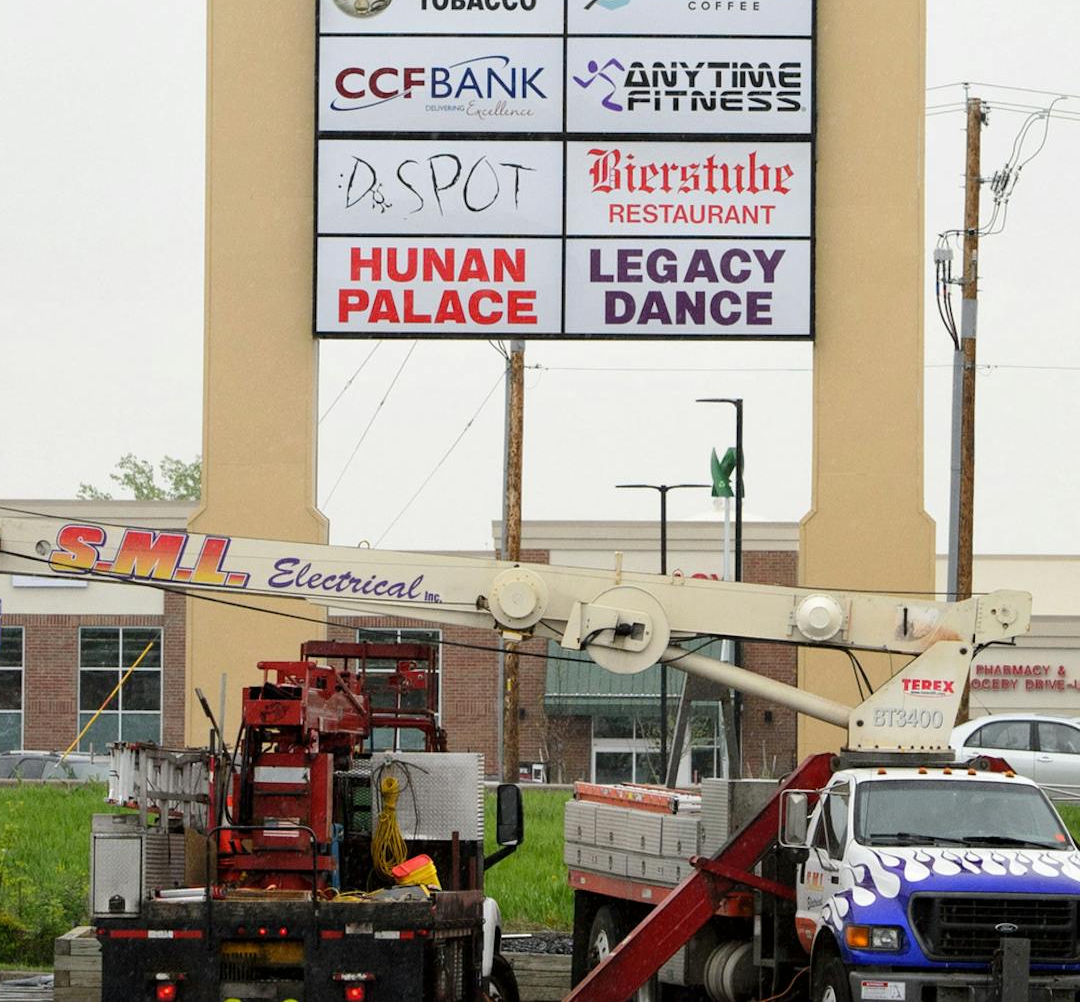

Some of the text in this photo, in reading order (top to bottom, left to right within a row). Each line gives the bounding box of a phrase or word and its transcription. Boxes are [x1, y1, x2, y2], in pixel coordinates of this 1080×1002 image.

[688, 1, 760, 11] COFFEE
[624, 61, 801, 88] ANYTIME
[425, 99, 535, 119] DELIVERING Excellence
[627, 90, 802, 112] FITNESS
[587, 149, 794, 195] Bierstube
[609, 204, 776, 225] RESTAURANT
[350, 247, 526, 283] HUNAN
[589, 248, 786, 285] LEGACY
[338, 289, 538, 325] PALACE
[604, 290, 773, 326] DANCE
[49, 524, 251, 588] S.M.L.
[268, 557, 424, 600] Electrical
[975, 664, 1066, 677] PHARMACY &
[902, 678, 955, 693] TEREX
[872, 708, 944, 729] BT3400
